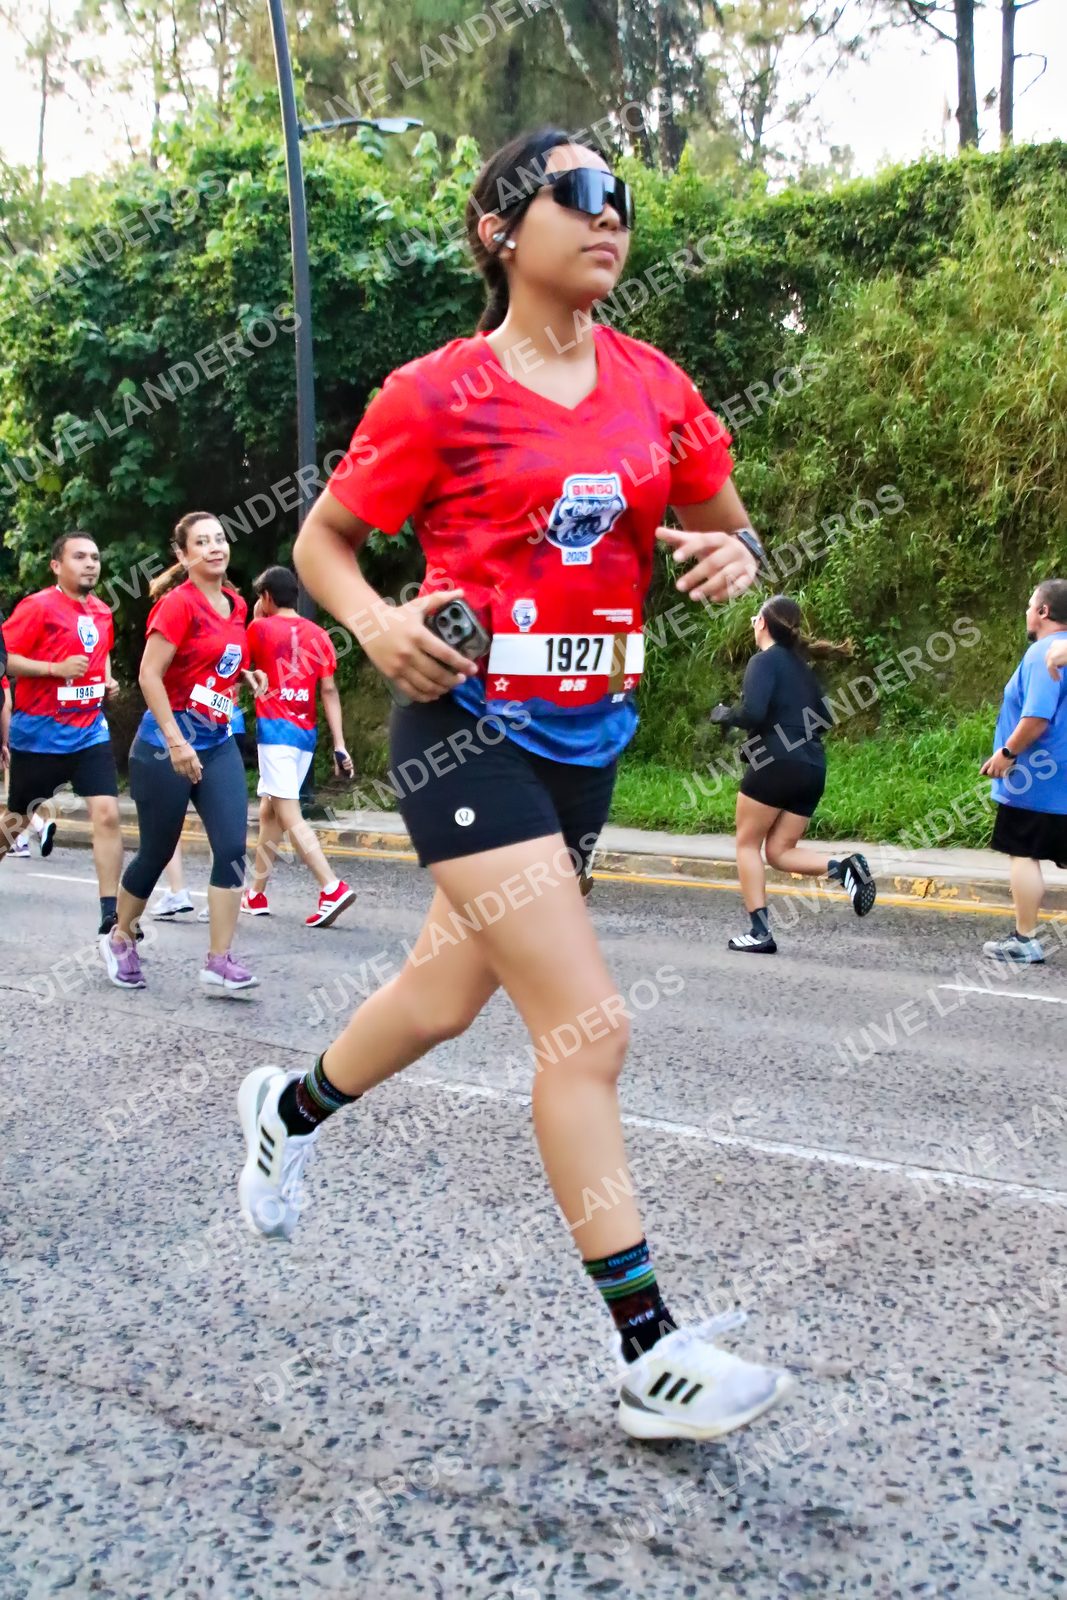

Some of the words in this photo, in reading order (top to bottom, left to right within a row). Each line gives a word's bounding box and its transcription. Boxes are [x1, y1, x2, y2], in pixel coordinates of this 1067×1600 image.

[572, 484, 613, 496] BIMBO
[545, 637, 604, 672] 1927
[75, 687, 94, 699] 1946
[280, 687, 309, 701] 20-26
